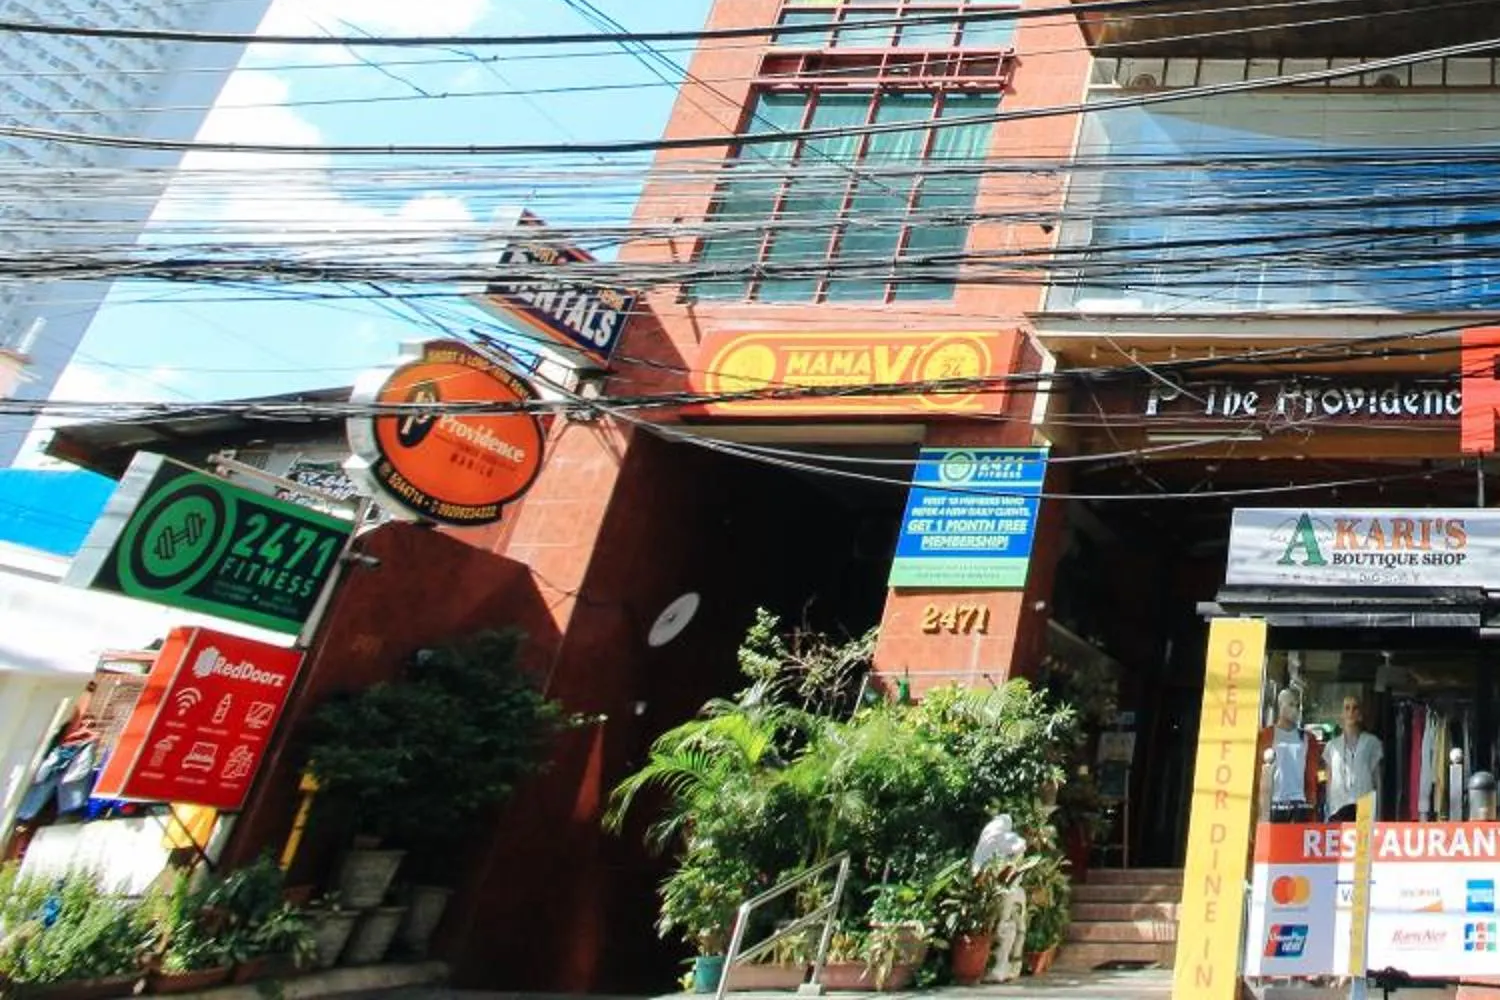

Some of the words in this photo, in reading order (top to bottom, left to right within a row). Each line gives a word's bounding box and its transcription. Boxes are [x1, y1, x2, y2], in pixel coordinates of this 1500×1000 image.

[510, 246, 616, 347] NTALS
[784, 351, 871, 375] MAMA
[871, 346, 917, 386] V
[1276, 384, 1463, 416] Providenc
[438, 411, 525, 463] Providence
[231, 513, 337, 578] 2471
[907, 519, 933, 532] GET
[946, 519, 995, 532] MONTH
[998, 519, 1029, 532] FREE
[219, 556, 315, 598] FITNESS
[1332, 552, 1419, 567] BOUTIQUE
[1421, 552, 1467, 567] SHOP
[920, 602, 990, 634] 2471
[212, 655, 287, 688] RedDoorz
[1220, 638, 1245, 728] OPEN
[1213, 740, 1233, 810] FOR
[1204, 822, 1228, 924] DINE
[1194, 938, 1214, 989] IN
